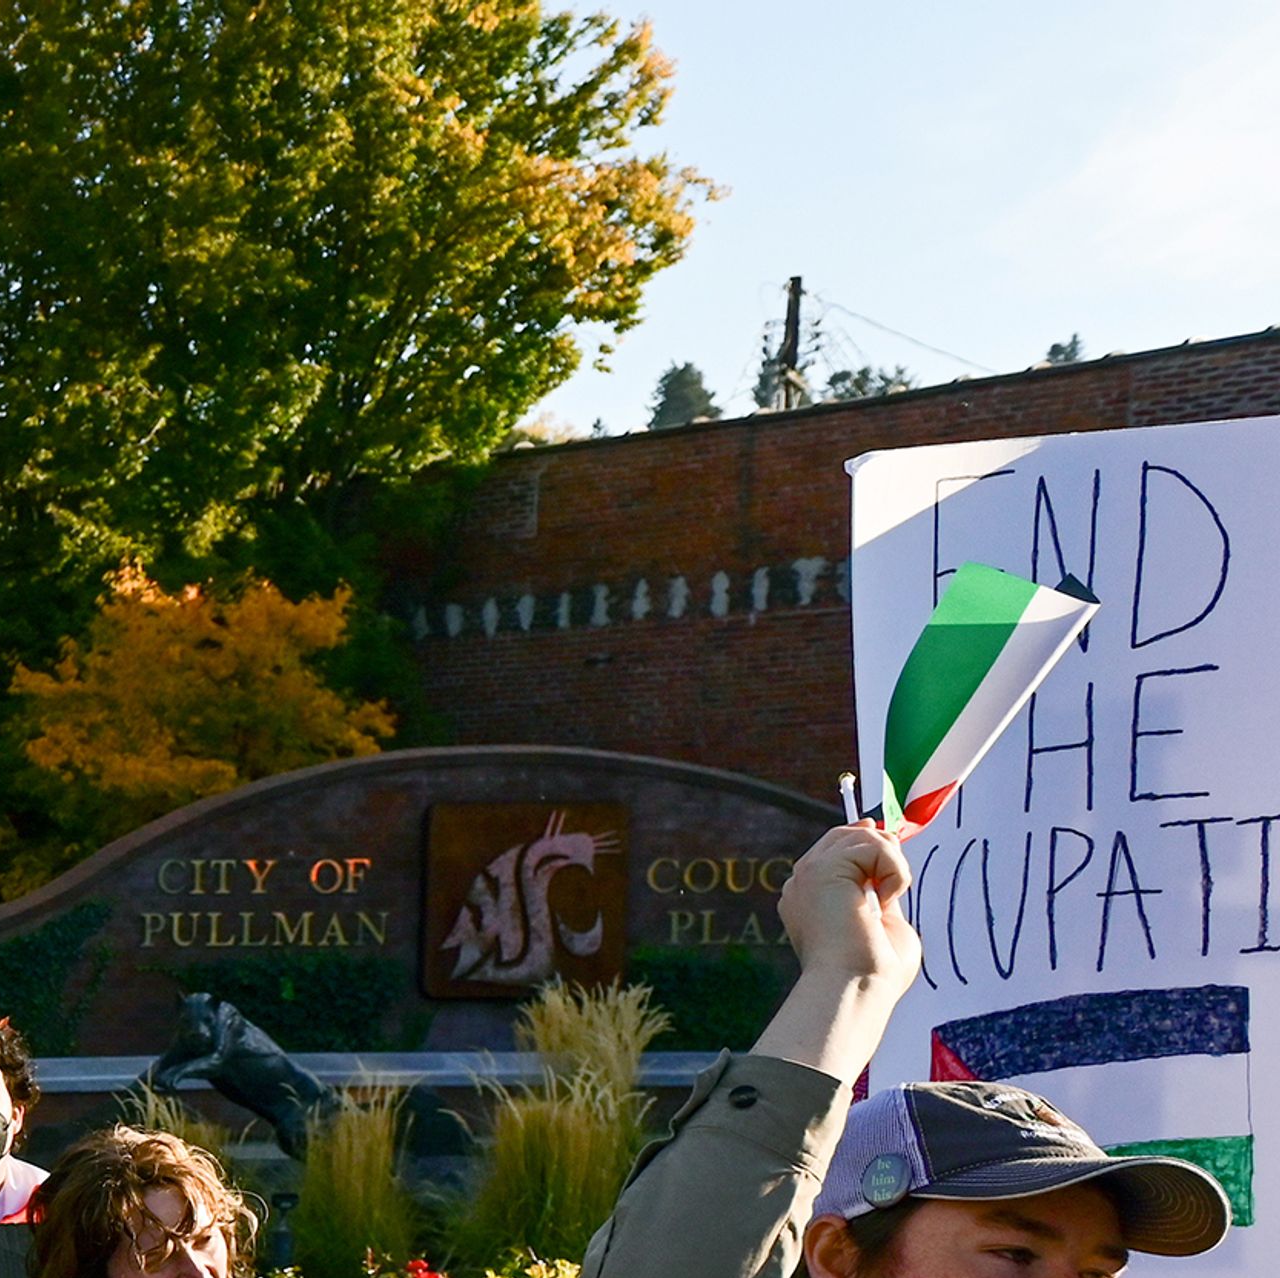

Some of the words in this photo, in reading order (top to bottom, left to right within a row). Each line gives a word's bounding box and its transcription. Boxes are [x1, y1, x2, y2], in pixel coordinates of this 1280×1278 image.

[956, 664, 1219, 828] HE
[157, 858, 277, 895] CITY
[309, 857, 372, 895] OF
[908, 815, 1280, 990] CCUPATI
[140, 911, 389, 948] PULLMAN
[667, 909, 793, 946] PLA
[871, 1173, 896, 1187] him
[877, 1158, 892, 1170] he
[873, 1188, 892, 1202] his
